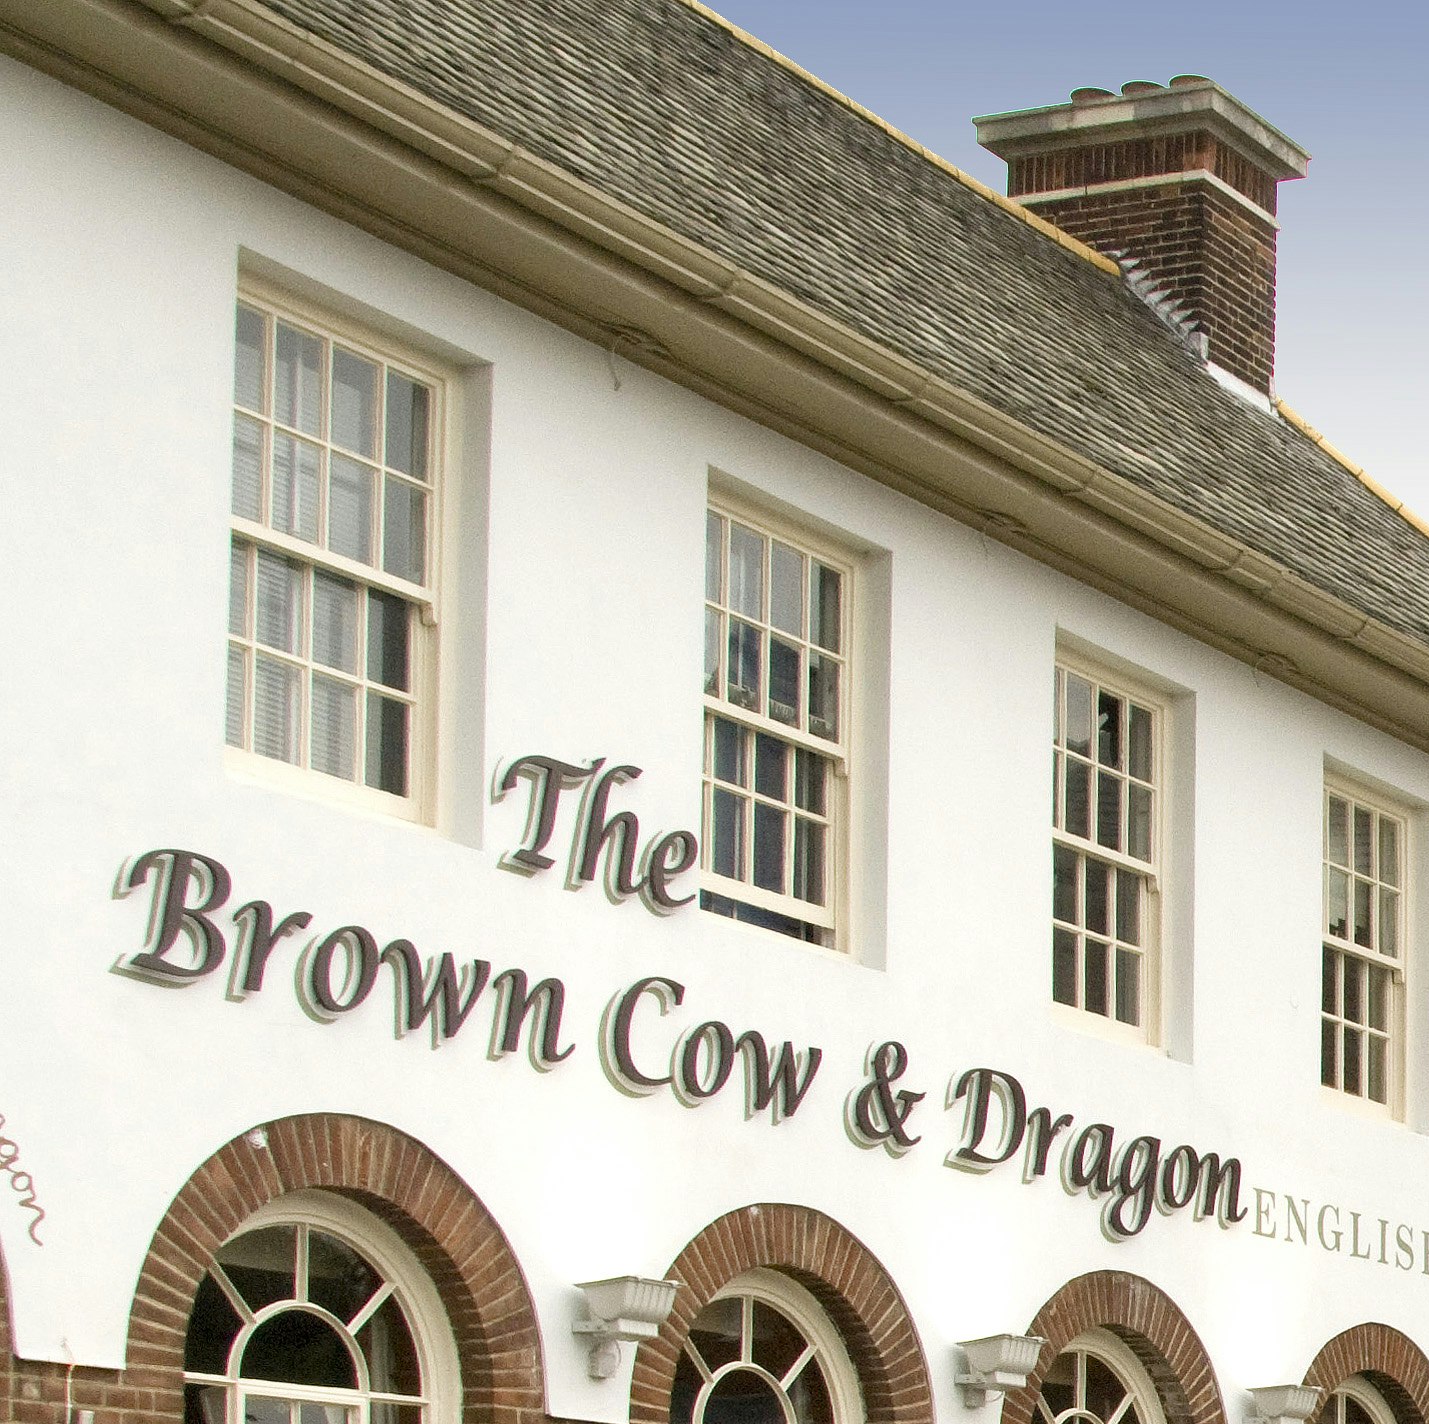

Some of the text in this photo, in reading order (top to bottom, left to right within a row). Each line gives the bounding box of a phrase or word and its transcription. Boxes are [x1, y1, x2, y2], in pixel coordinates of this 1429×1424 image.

[495, 754, 698, 914] The
[114, 848, 1248, 1242] Brown Cow & Dragon
